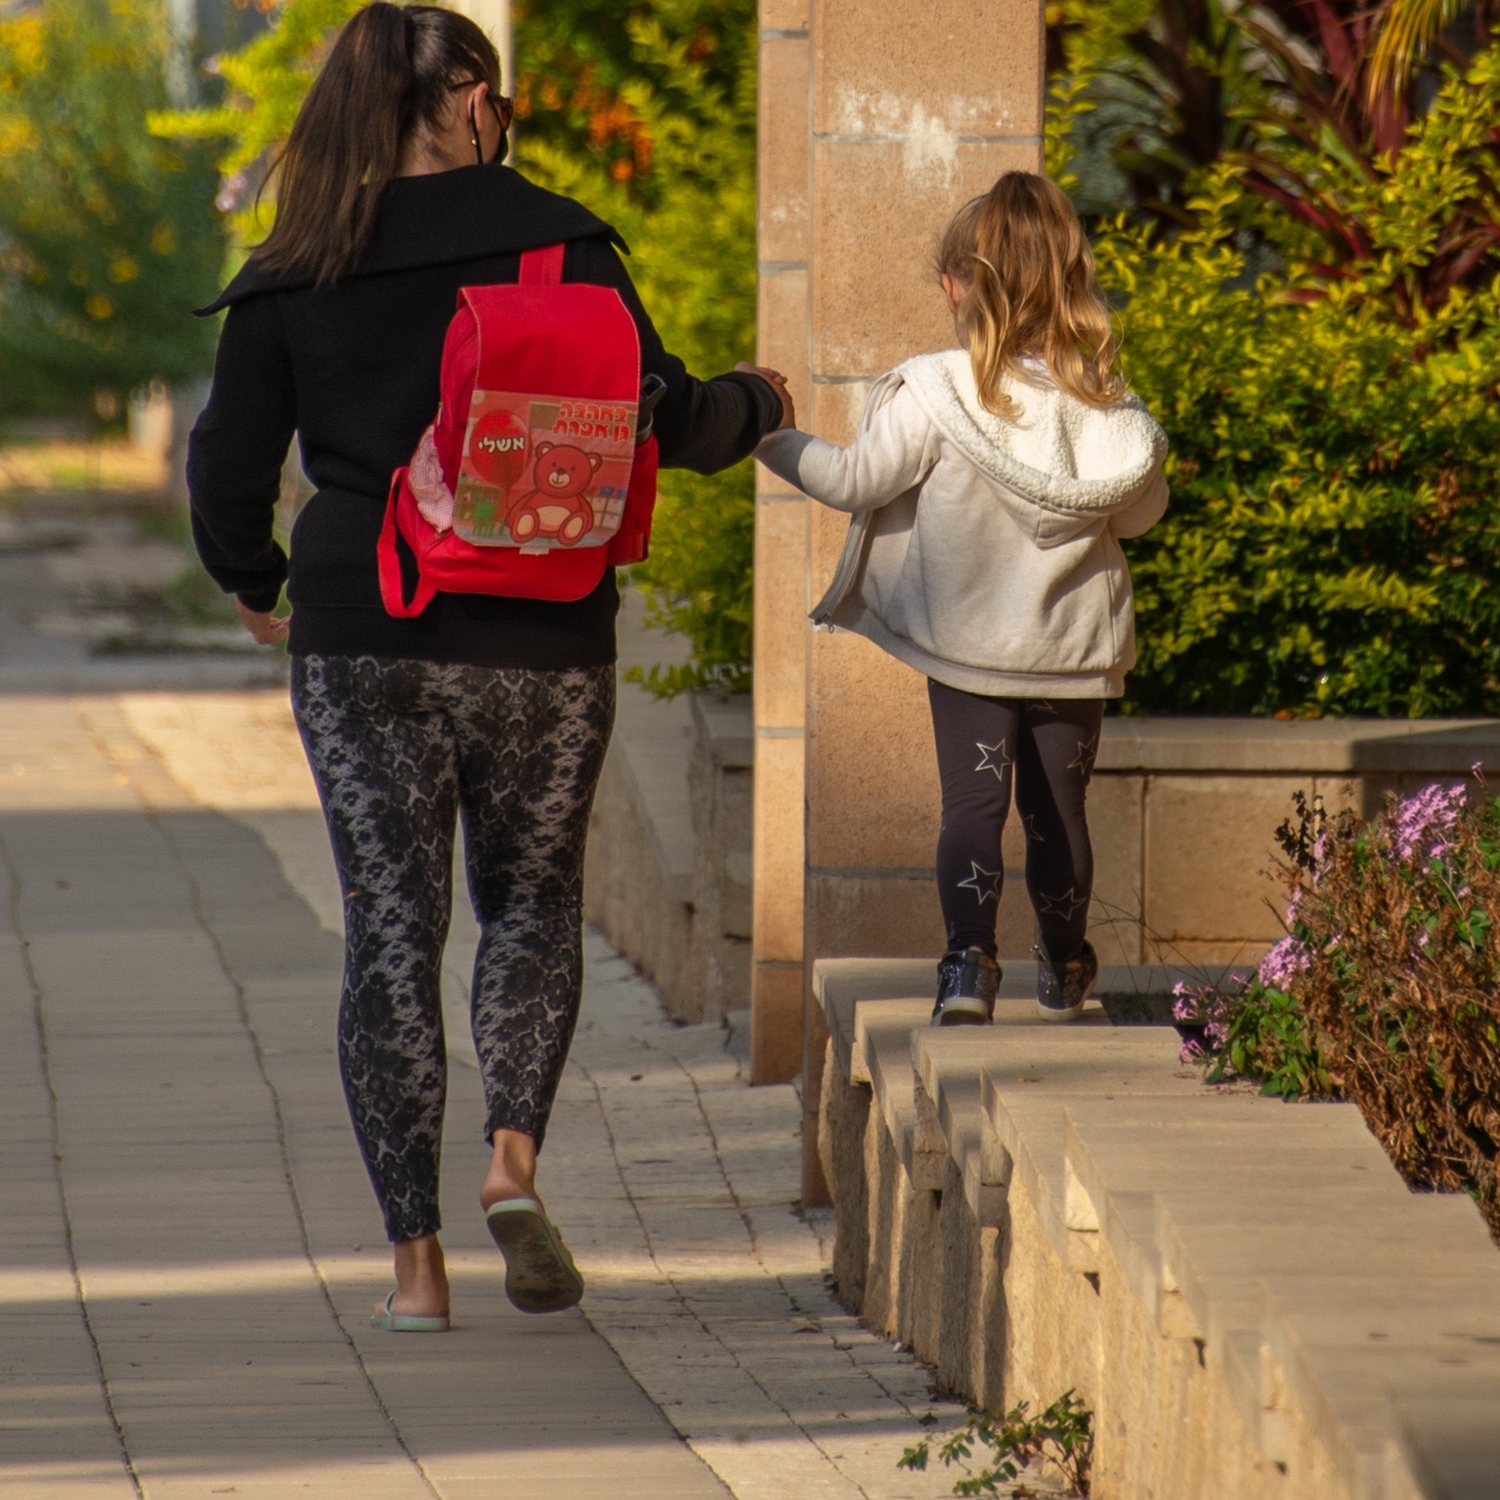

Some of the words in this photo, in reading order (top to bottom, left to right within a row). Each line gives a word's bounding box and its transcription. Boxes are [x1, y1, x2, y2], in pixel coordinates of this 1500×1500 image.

[559, 401, 628, 423] באהבה
[552, 419, 609, 439] אפרת
[613, 424, 630, 443] גן
[477, 436, 526, 453] אשלי
